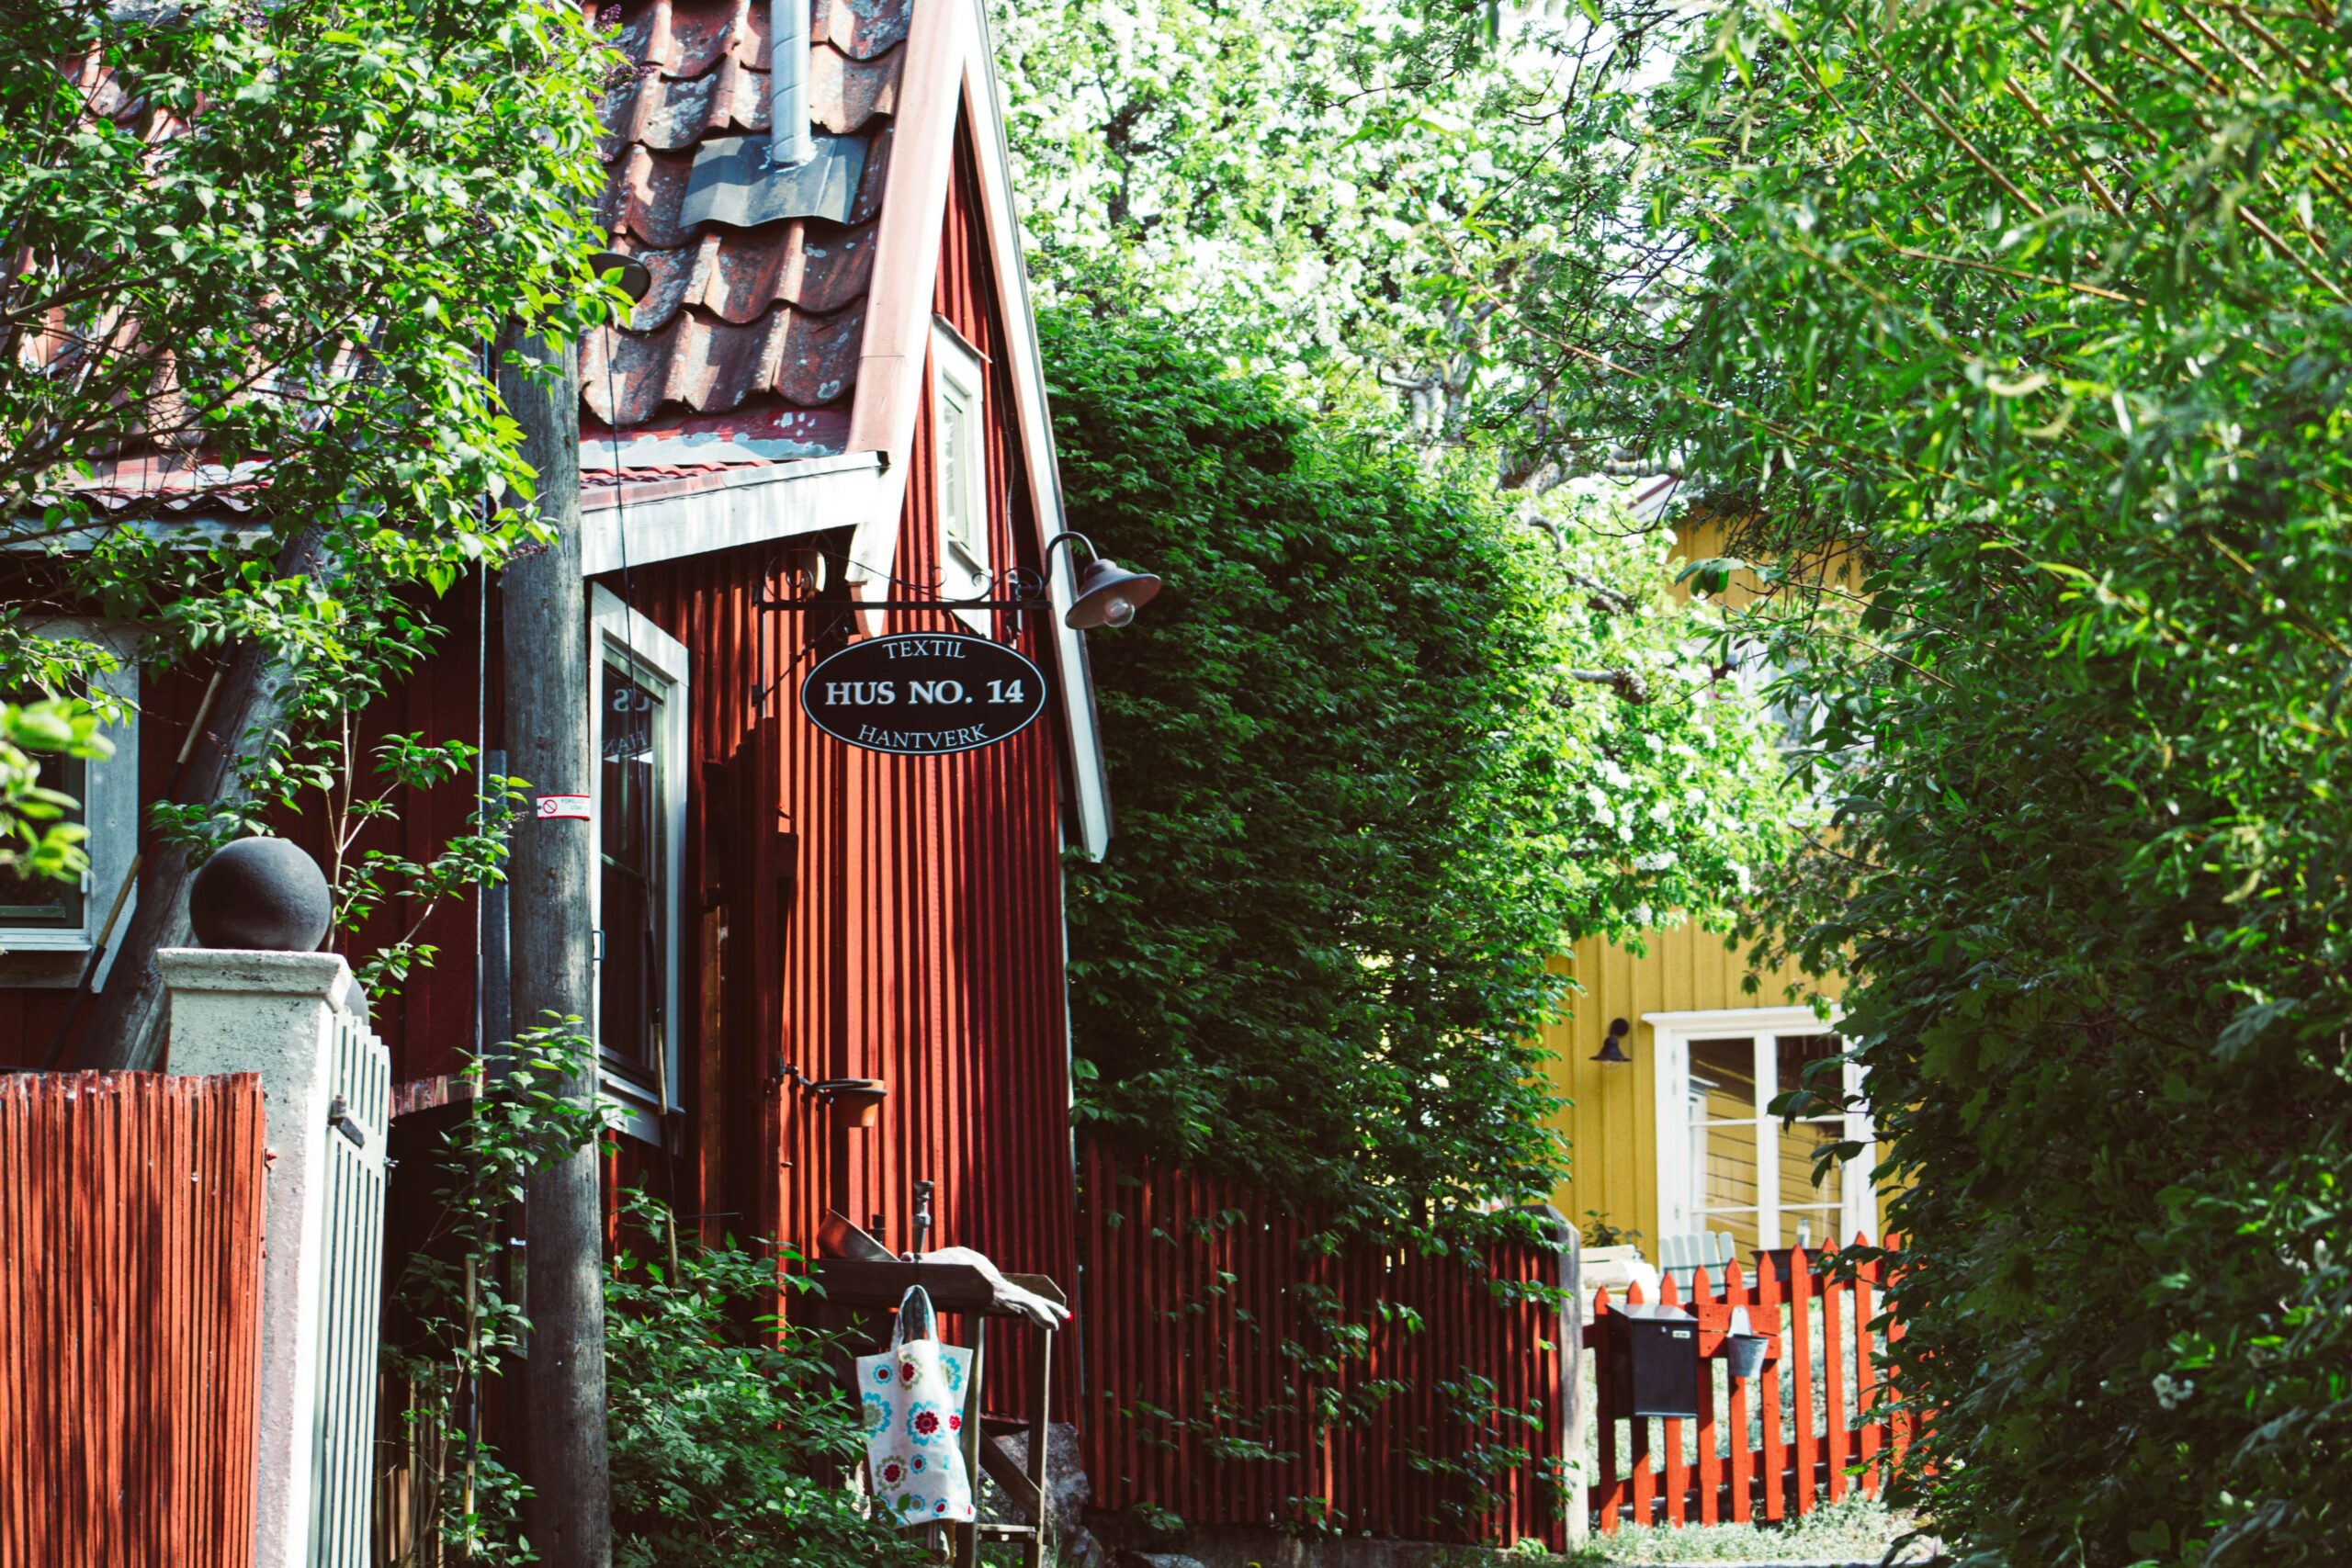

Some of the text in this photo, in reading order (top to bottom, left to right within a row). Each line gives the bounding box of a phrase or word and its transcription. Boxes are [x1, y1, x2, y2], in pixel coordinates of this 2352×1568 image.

[883, 640, 966, 659] TEXTIL
[825, 680, 1023, 705] HUS NO. 14
[858, 725, 988, 748] HANTVERK
